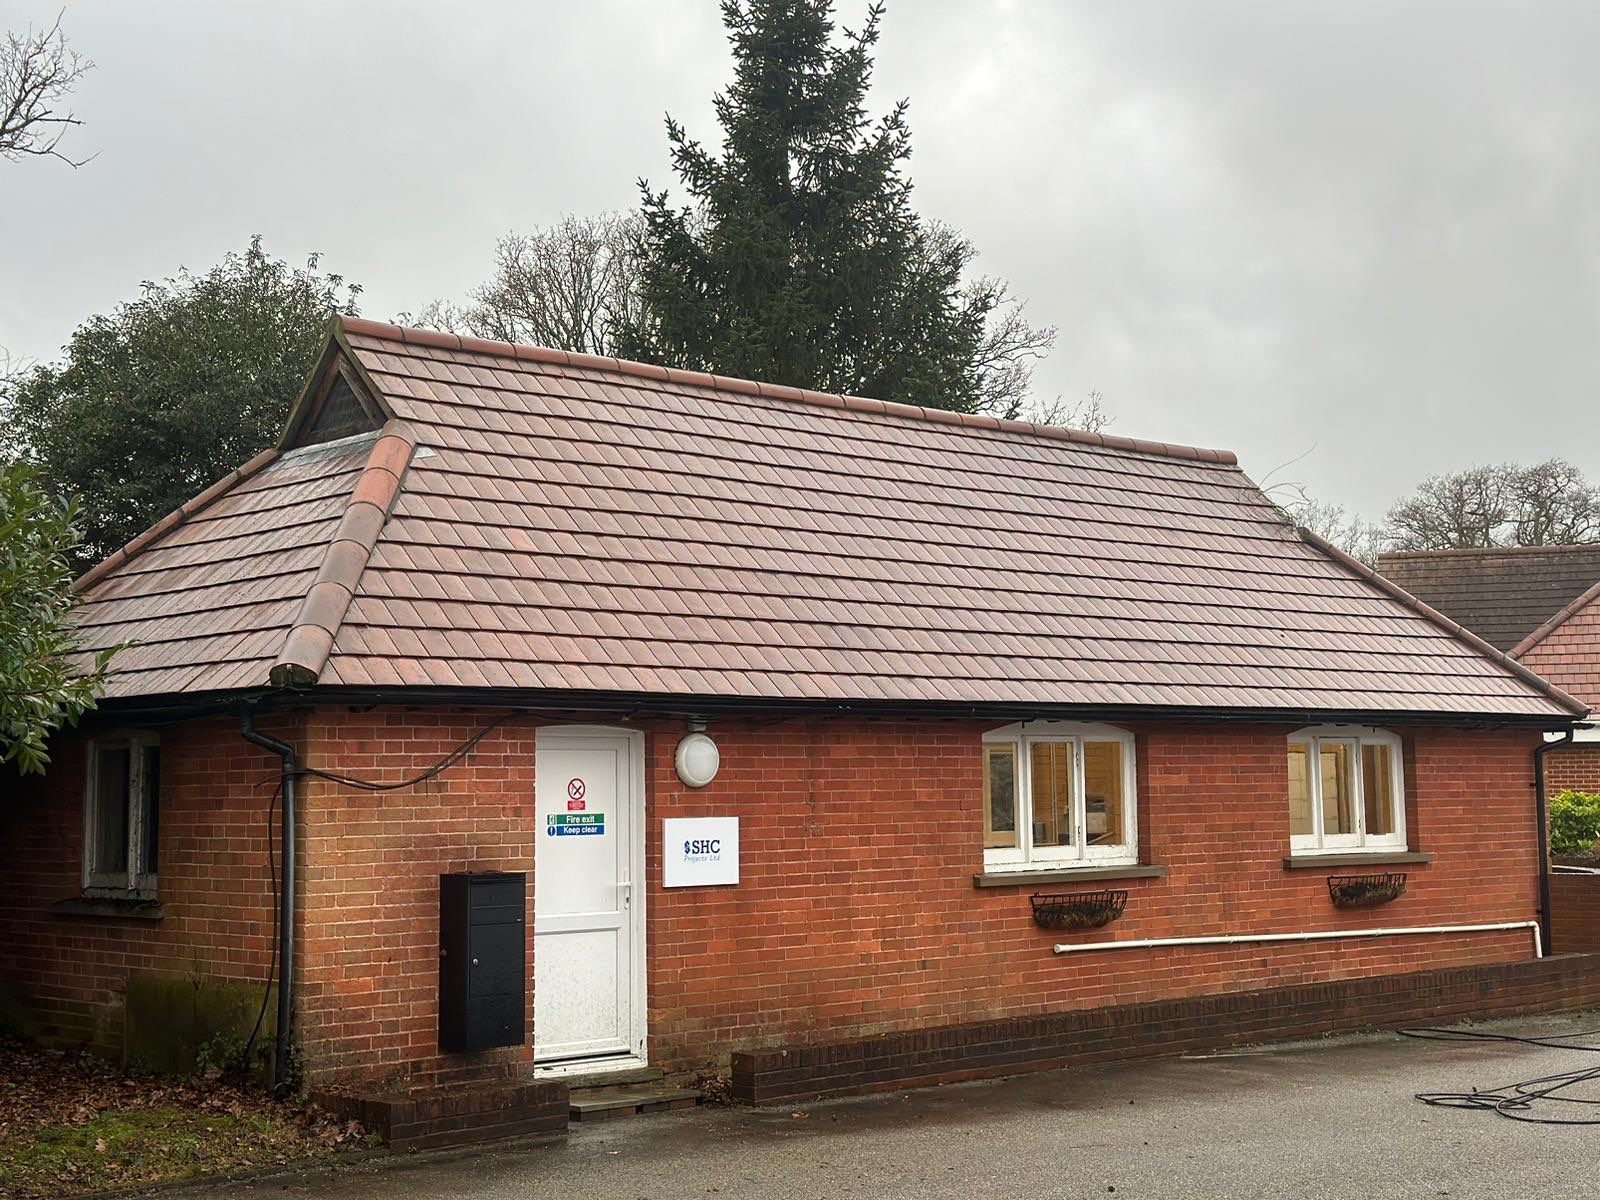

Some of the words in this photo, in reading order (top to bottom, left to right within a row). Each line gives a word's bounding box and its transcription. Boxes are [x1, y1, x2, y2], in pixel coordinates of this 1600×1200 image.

[566, 815, 580, 824] Fire
[581, 815, 595, 823] exit
[563, 826, 581, 835] Keep
[692, 839, 721, 854] SHC
